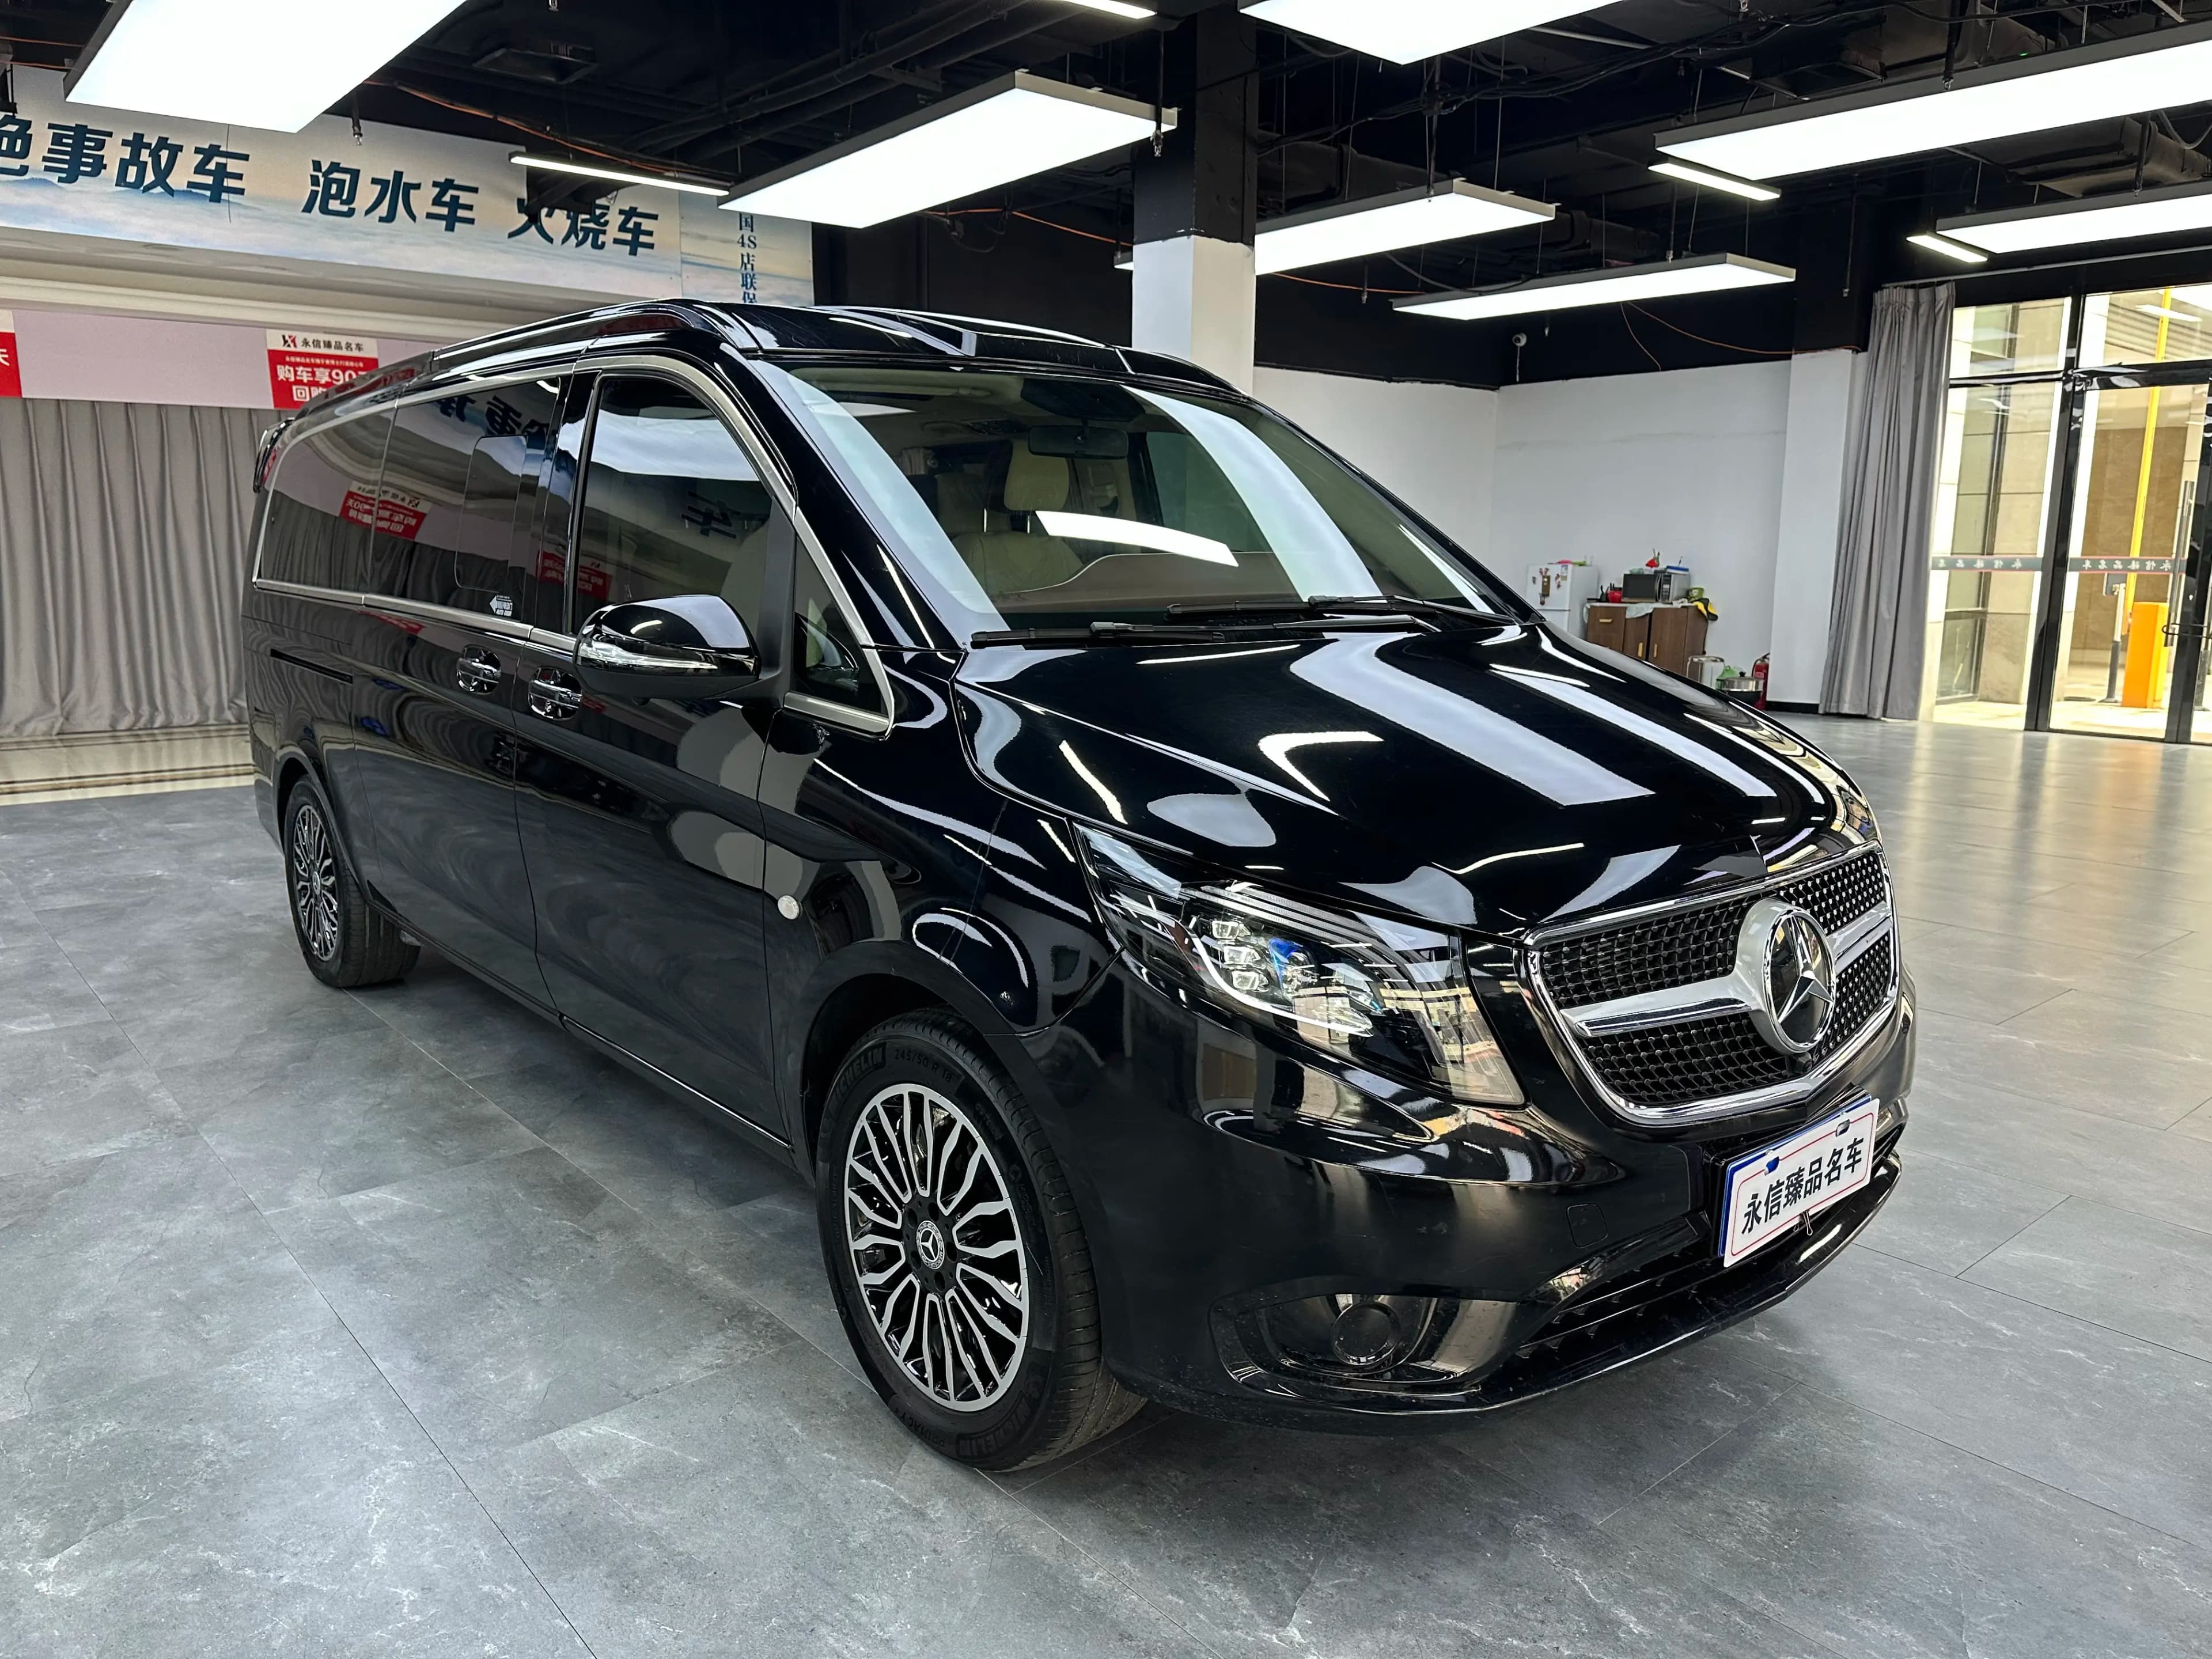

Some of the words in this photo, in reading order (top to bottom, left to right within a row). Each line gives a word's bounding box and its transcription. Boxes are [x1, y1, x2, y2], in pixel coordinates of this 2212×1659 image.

[301, 159, 479, 233] 泡水车
[301, 338, 364, 353] 永信臻品名车
[276, 364, 369, 385] 购车享90
[895, 1049, 929, 1066] 245/50
[931, 1062, 939, 1073] R
[942, 1070, 953, 1084] 18
[1741, 1137, 1864, 1235] 永信臻品名车
